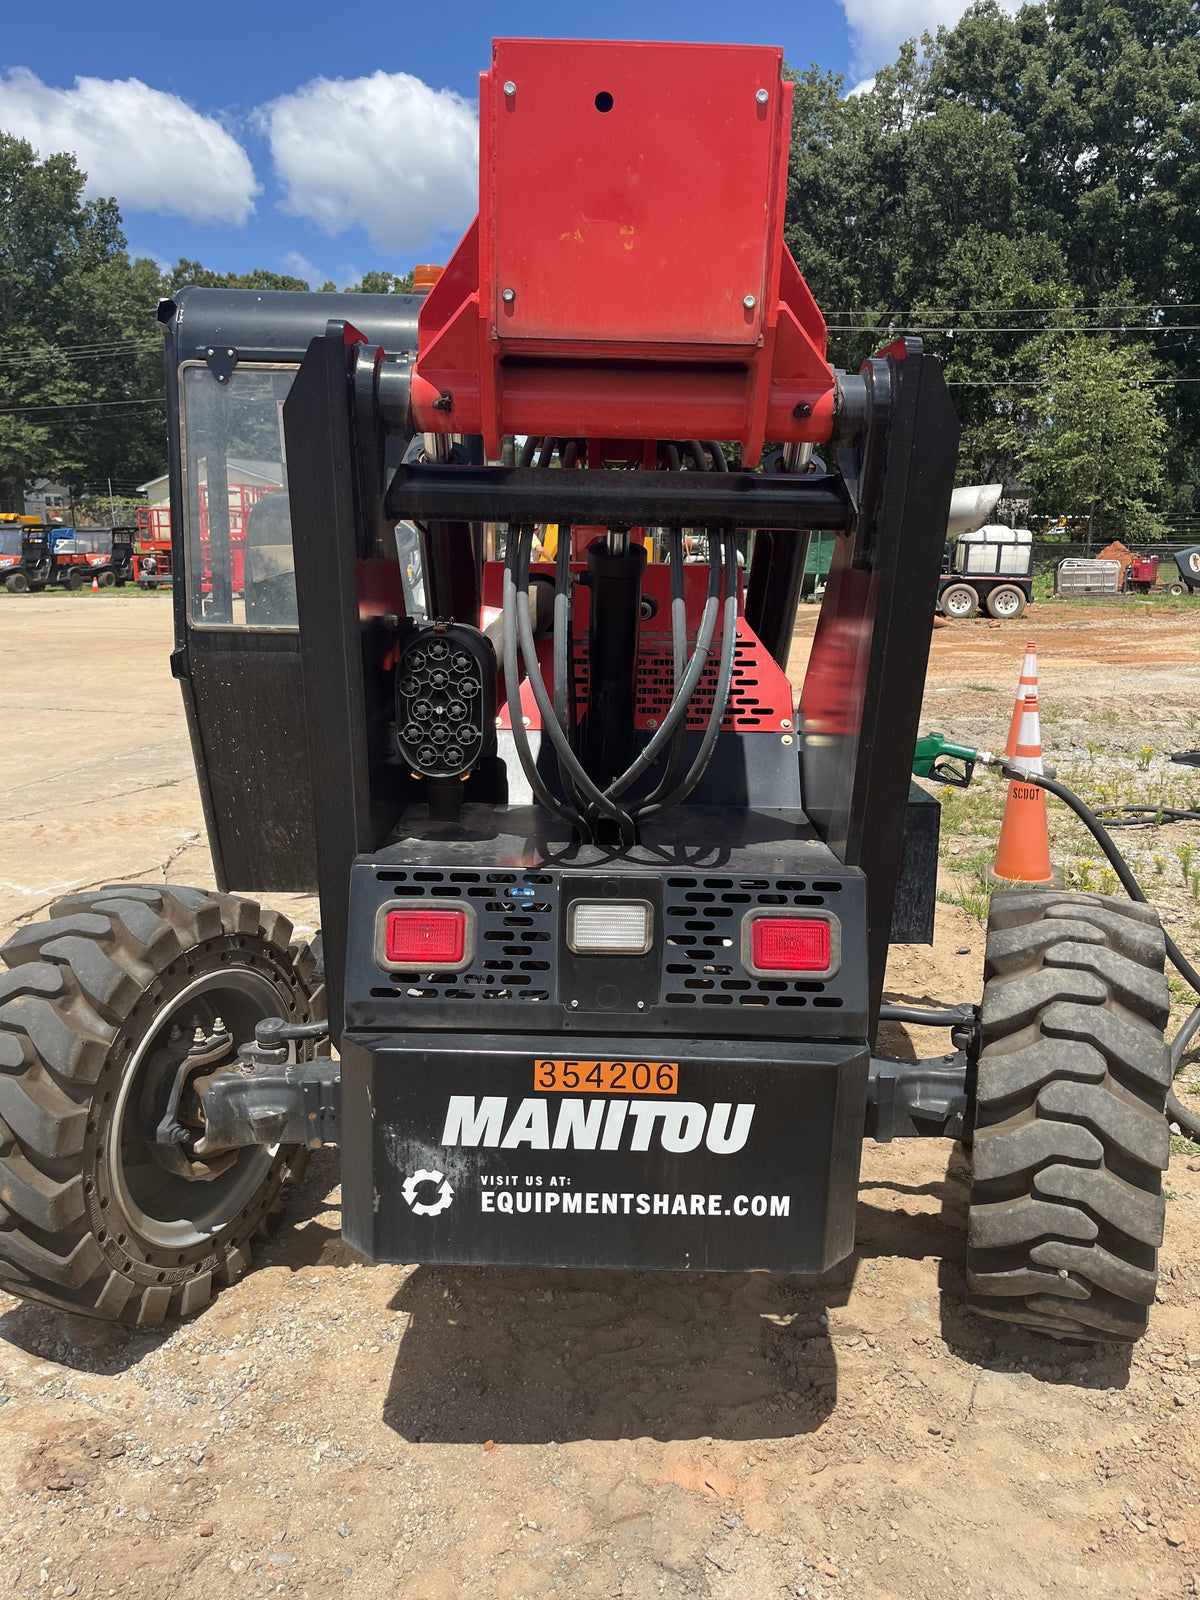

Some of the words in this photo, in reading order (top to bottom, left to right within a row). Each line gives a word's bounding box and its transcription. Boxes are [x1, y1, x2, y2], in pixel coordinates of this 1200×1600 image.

[1013, 787, 1040, 800] SCDOT
[538, 1061, 674, 1091] 354206
[441, 1096, 755, 1154] MANITOU
[480, 1175, 519, 1186] VISIT
[525, 1175, 543, 1187] US
[549, 1175, 571, 1187] AT:
[481, 1191, 791, 1217] EQUIPMENTSHARE.COM
